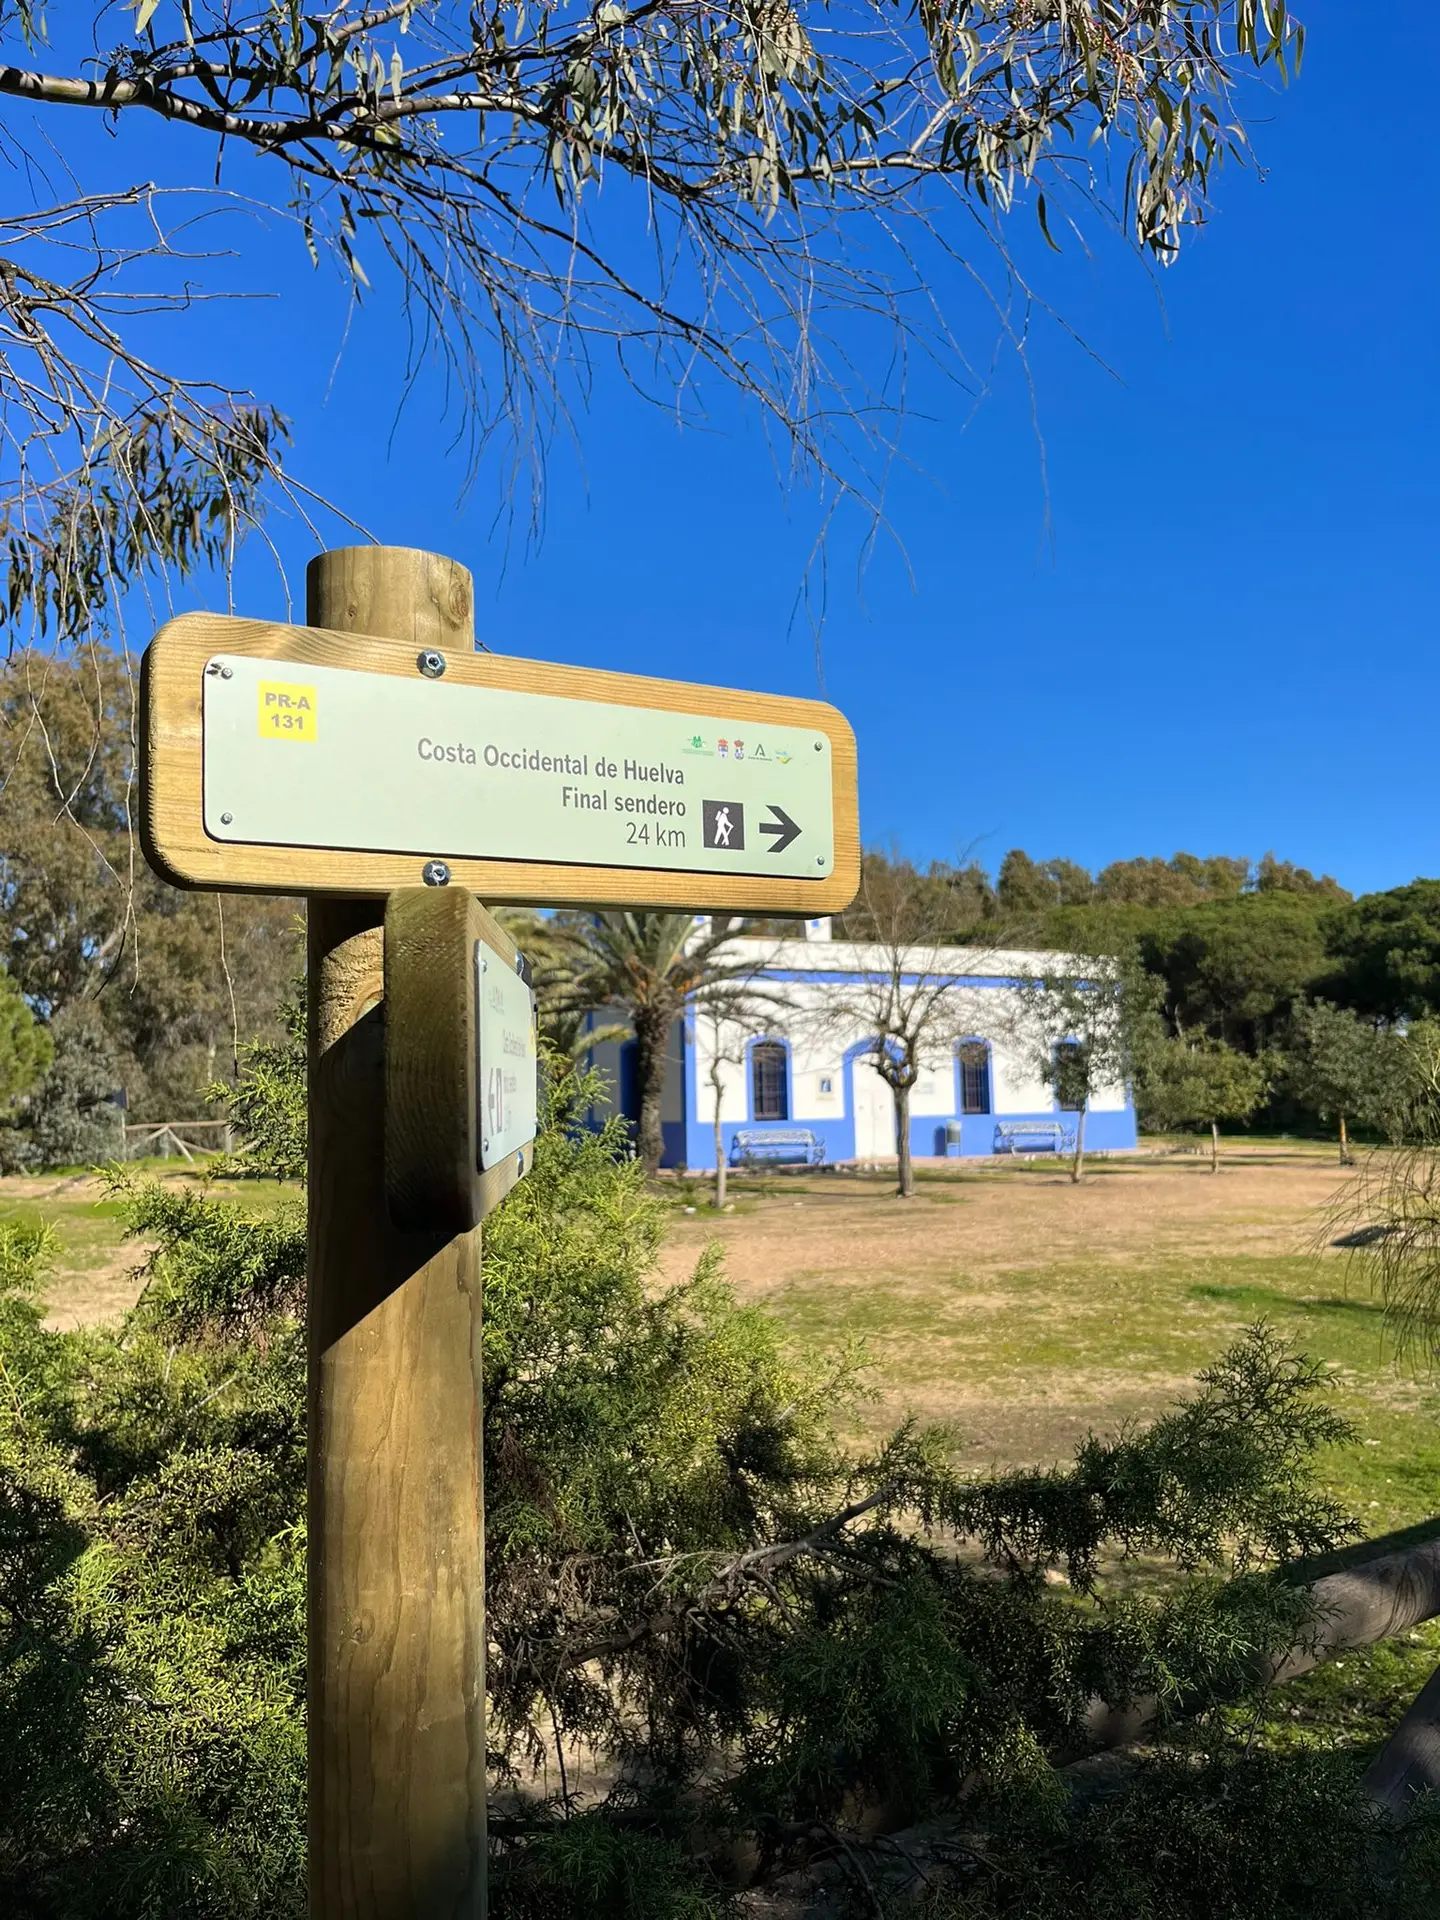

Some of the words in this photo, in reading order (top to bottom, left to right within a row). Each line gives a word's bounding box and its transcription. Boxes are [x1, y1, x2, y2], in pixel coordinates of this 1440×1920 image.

[265, 692, 311, 710] PR-A
[271, 713, 304, 730] 131
[417, 737, 477, 765] Costa
[483, 744, 589, 776] Occidental
[595, 756, 618, 778] de
[624, 759, 685, 785] Huelva
[562, 786, 607, 811] Final
[614, 794, 687, 817] sendero
[626, 821, 650, 846] 24
[656, 821, 686, 848] km
